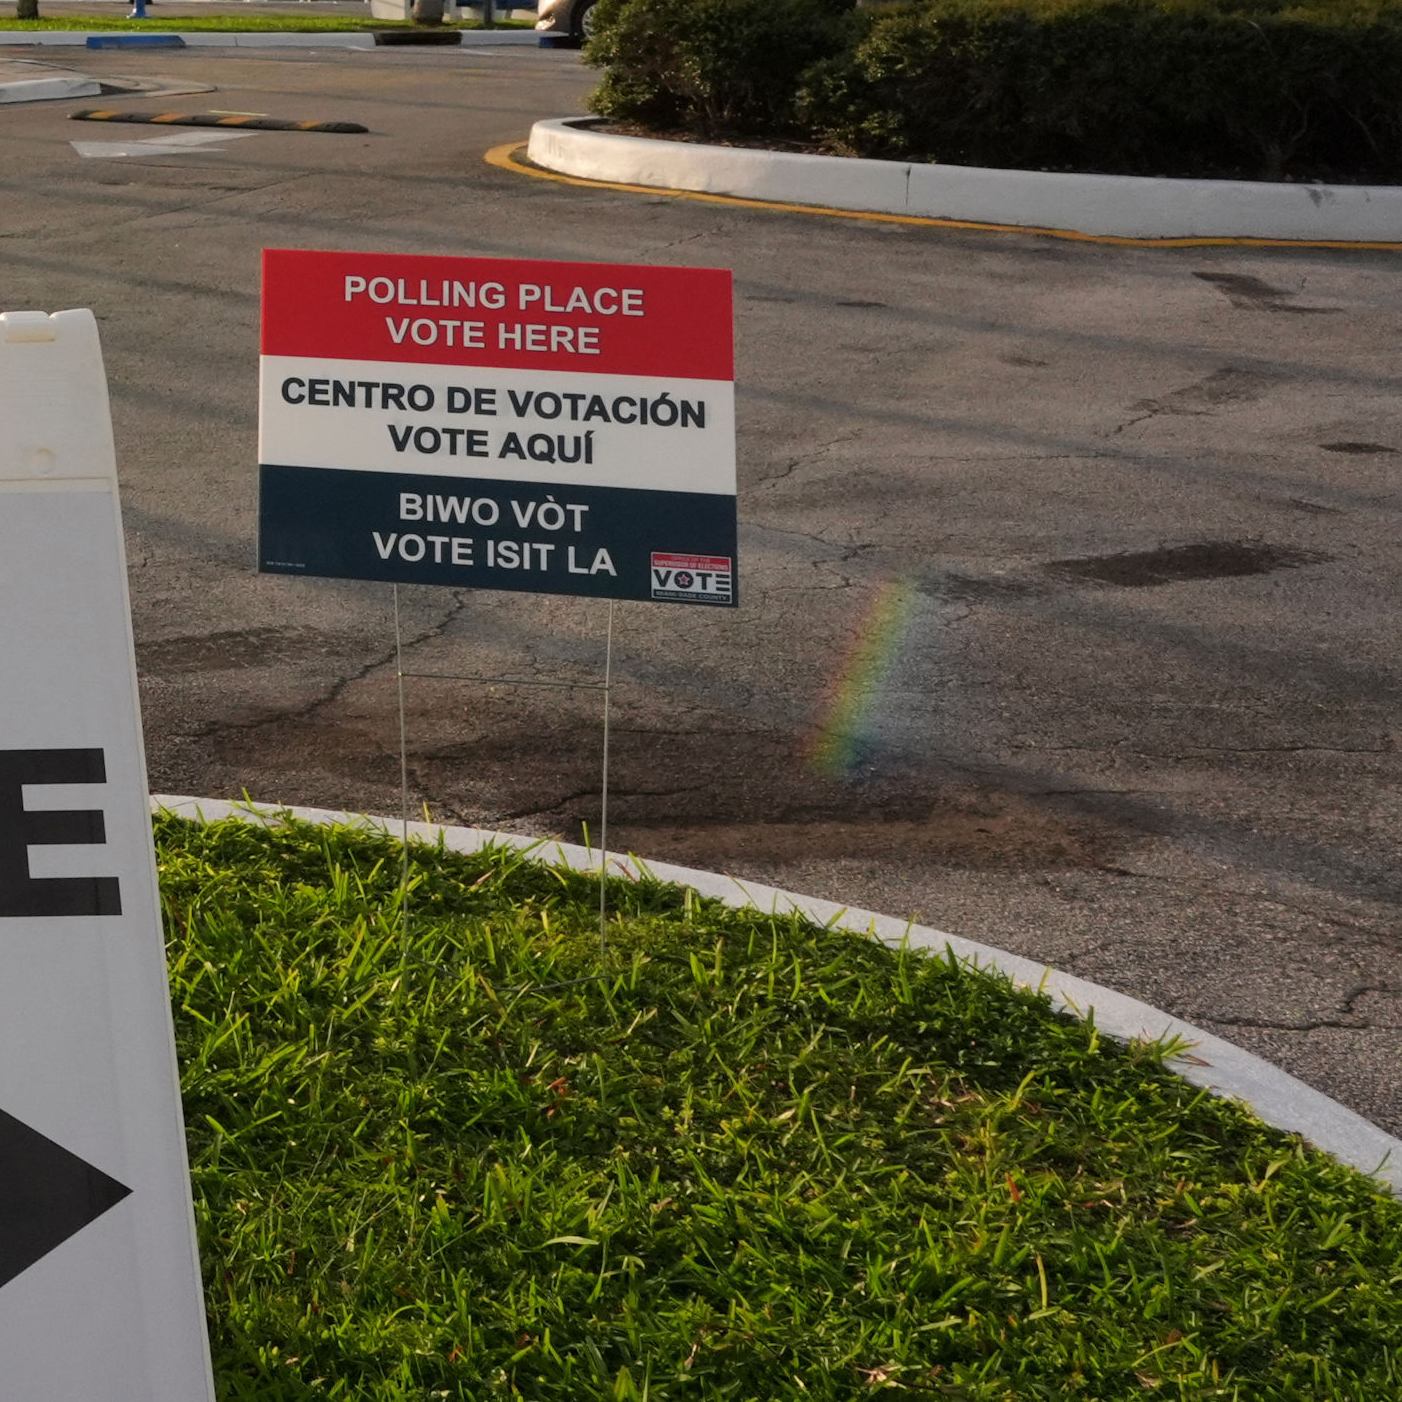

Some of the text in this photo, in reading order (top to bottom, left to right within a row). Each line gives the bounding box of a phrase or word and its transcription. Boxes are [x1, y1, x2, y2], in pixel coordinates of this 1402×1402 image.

[345, 275, 644, 316] POLLING PLACE
[385, 317, 600, 354] VOTE HERE
[281, 377, 706, 429] CENTRO DE VOTACIÓN
[387, 424, 595, 465] VOTE AQUÍ
[399, 492, 590, 532] BIWO VÒT
[372, 531, 618, 577] VOTE ISIT LA
[653, 569, 731, 592] VOTE
